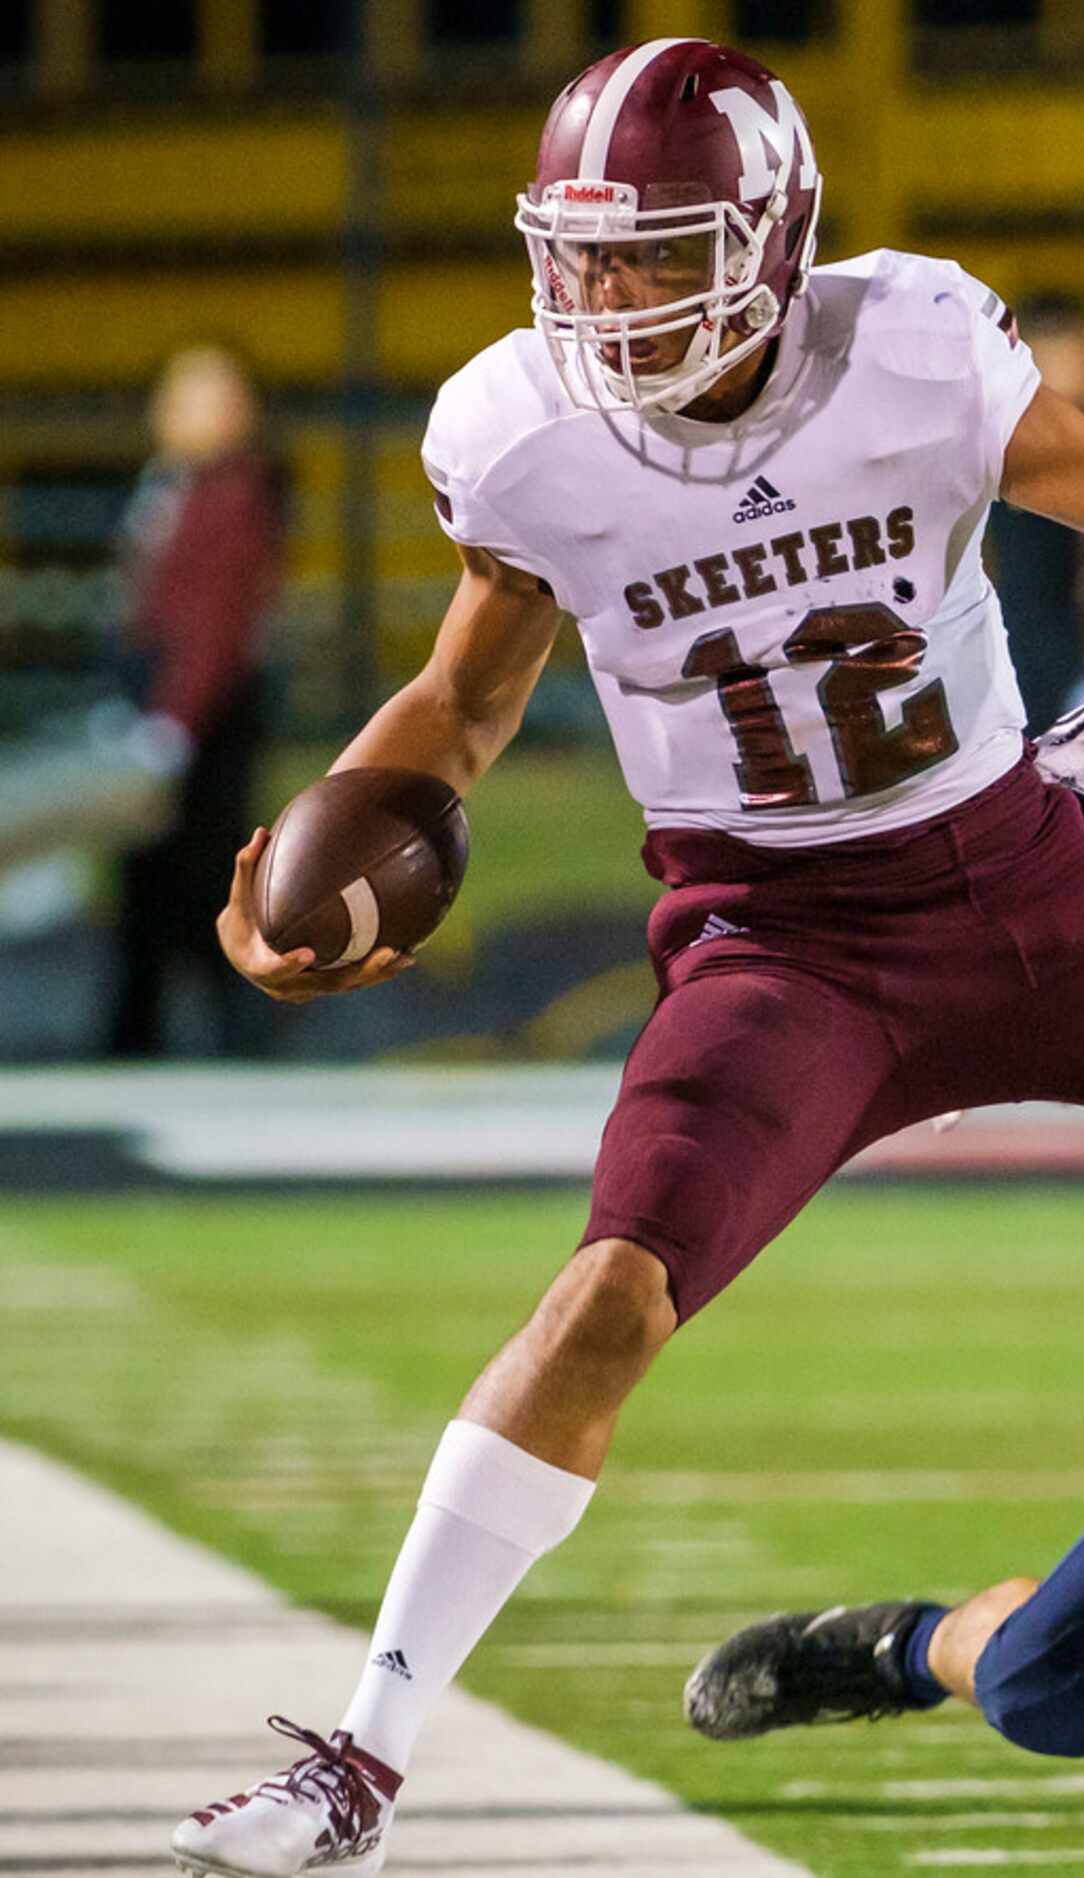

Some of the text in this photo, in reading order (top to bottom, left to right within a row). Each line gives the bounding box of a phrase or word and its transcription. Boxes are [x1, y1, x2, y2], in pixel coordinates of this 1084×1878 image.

[563, 184, 615, 204] Riddell
[708, 79, 818, 202] M
[624, 505, 915, 630] SKEETERS
[732, 499, 796, 525] adidas
[681, 600, 960, 811] 12
